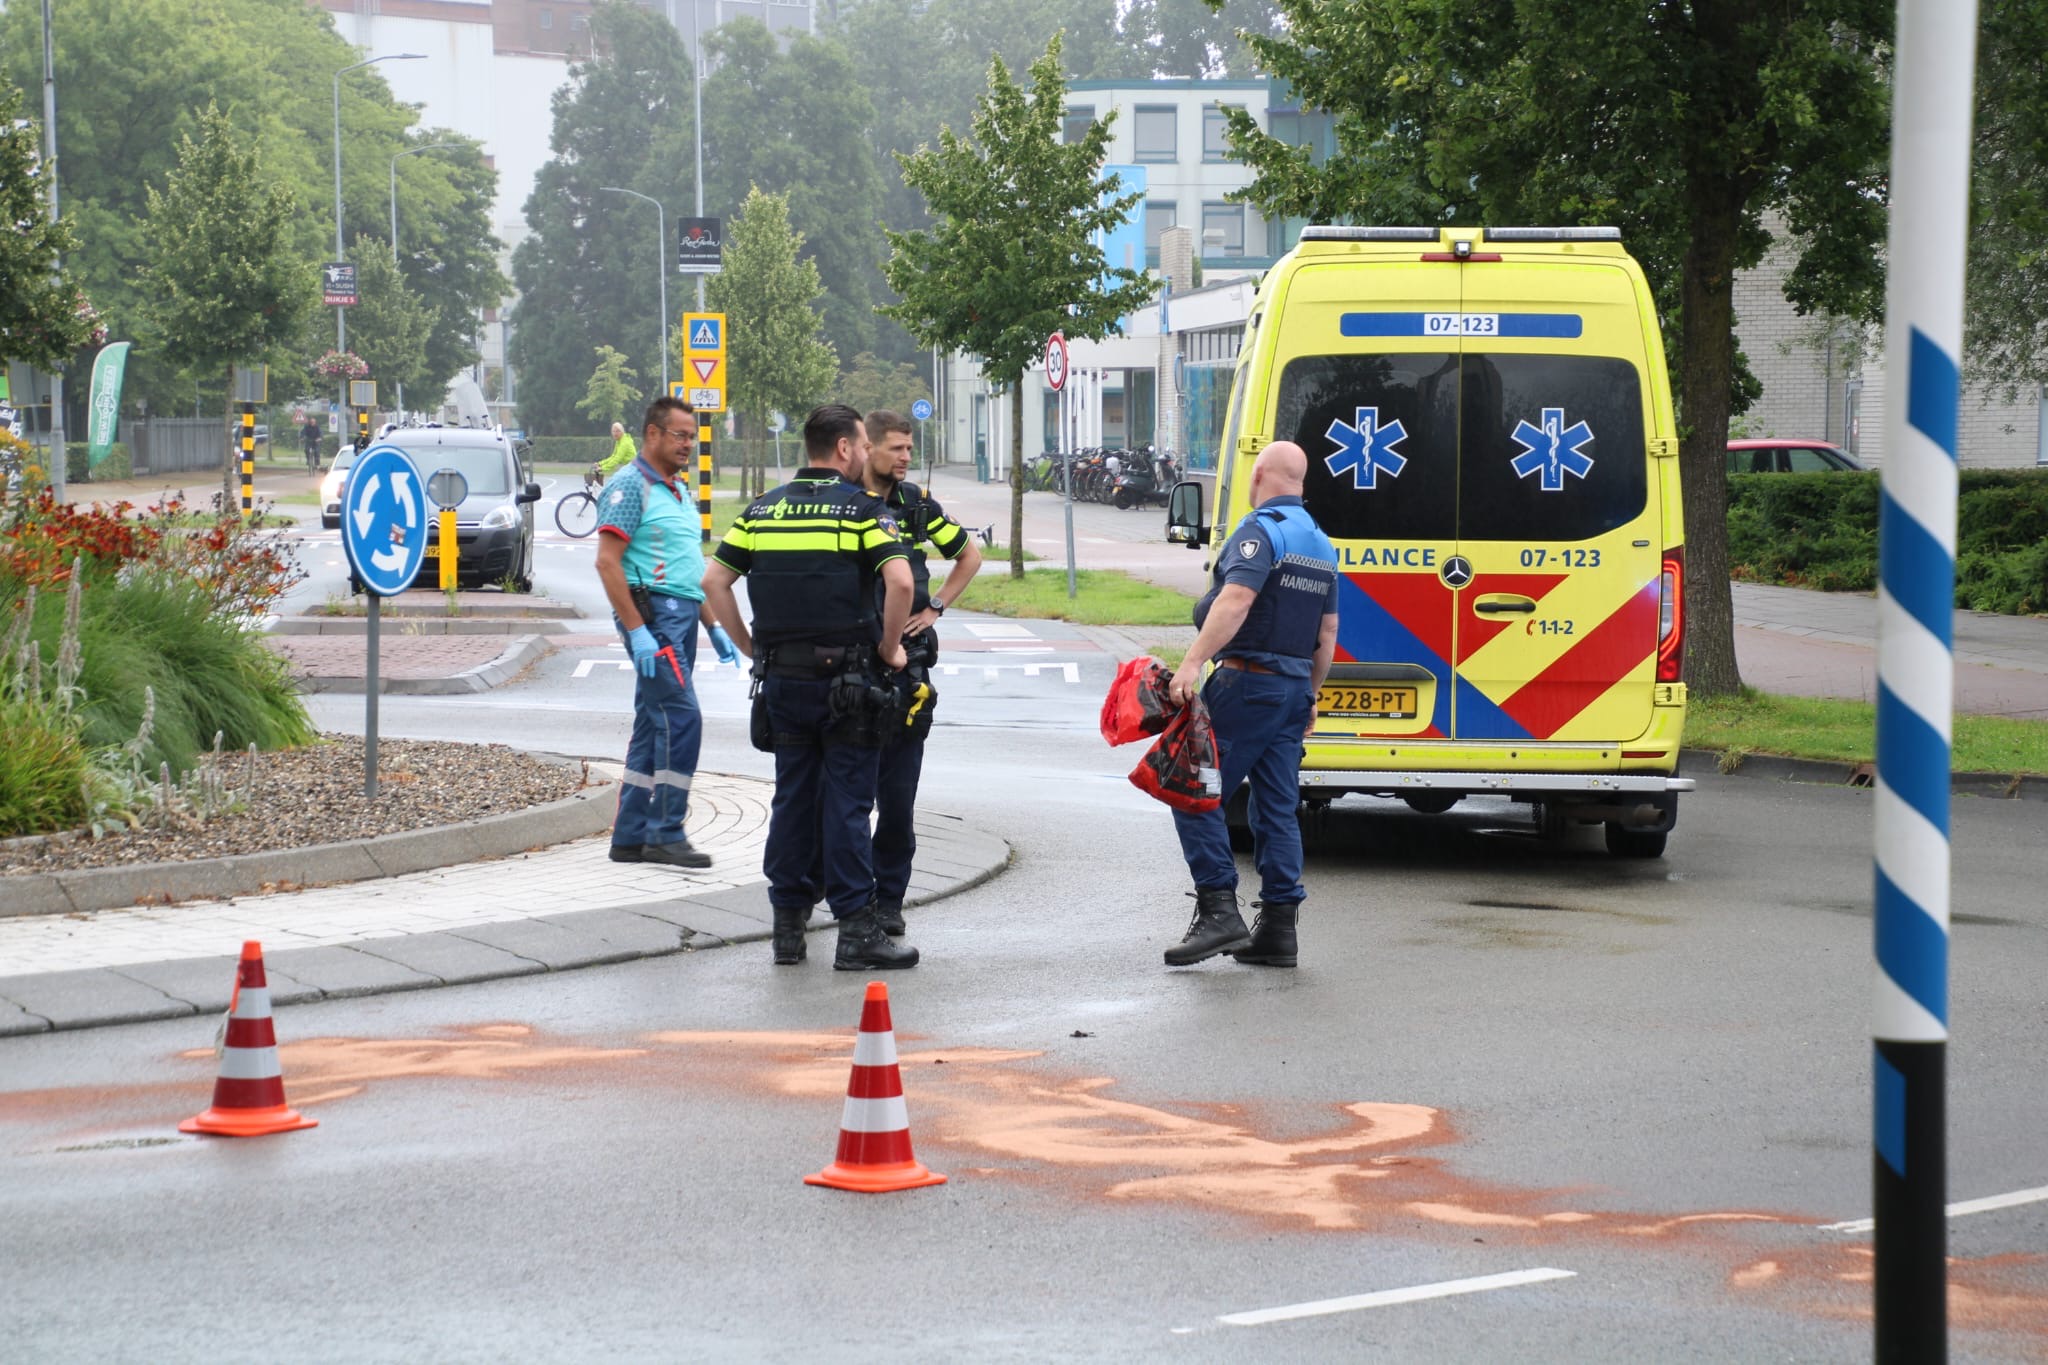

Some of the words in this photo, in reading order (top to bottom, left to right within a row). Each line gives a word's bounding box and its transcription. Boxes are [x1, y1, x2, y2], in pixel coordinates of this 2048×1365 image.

[1430, 317, 1494, 332] 07-123
[1050, 351, 1061, 372] 30
[766, 499, 831, 519] POLITIE
[1335, 547, 1436, 566] LANCE
[1520, 549, 1601, 567] 07-123
[1538, 620, 1574, 635] 1-1-2
